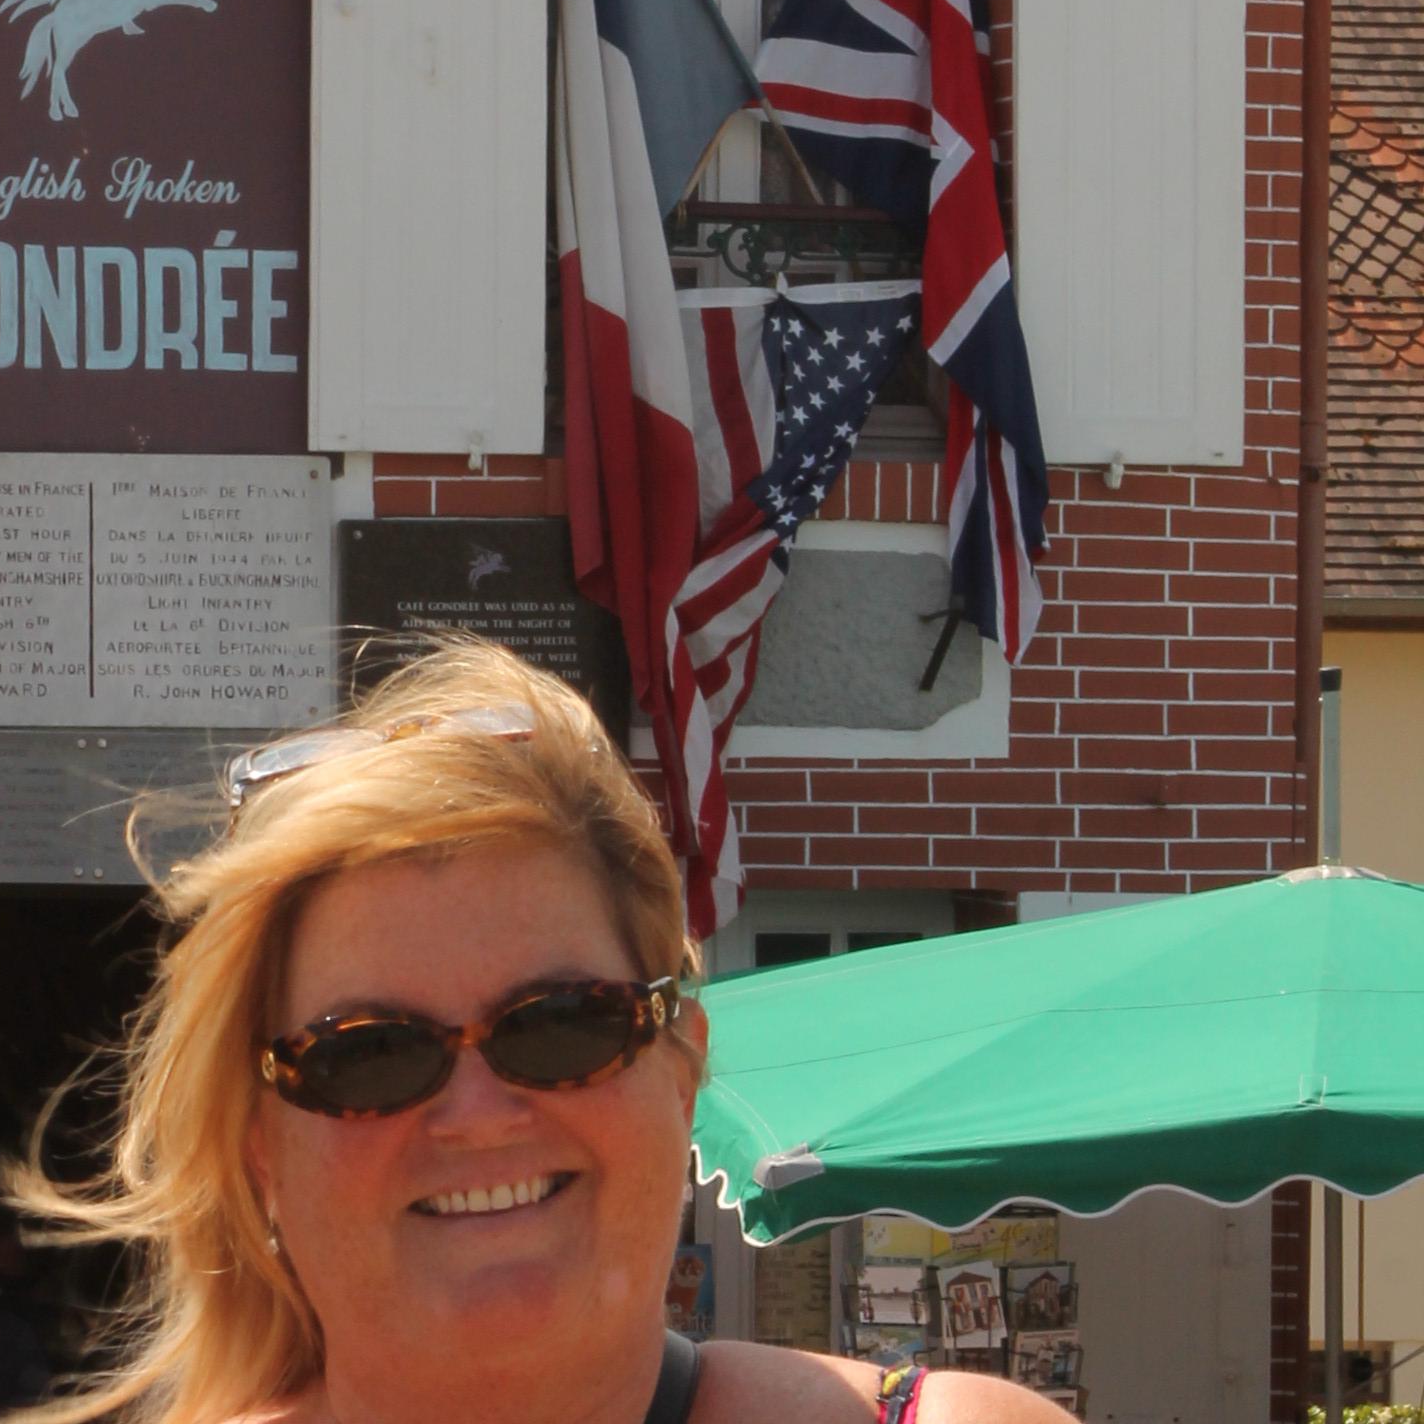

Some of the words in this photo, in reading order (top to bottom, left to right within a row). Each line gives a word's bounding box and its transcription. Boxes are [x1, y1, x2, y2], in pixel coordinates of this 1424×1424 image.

[104, 156, 241, 219] Spoken
[18, 483, 31, 495] IN
[34, 481, 85, 496] FRANCE
[149, 484, 209, 498] MAISON
[219, 486, 236, 498] DE
[30, 529, 71, 541] HOUR
[108, 529, 147, 542] DANS
[158, 530, 175, 542] LA
[6, 550, 32, 562] MEN
[37, 550, 51, 563] OF
[61, 550, 84, 563] THE
[110, 552, 128, 564] DU
[138, 552, 146, 564] 5
[160, 552, 198, 565] JUIN
[211, 553, 248, 565] 1944
[296, 553, 313, 566] LA
[148, 596, 188, 610] LIGHT
[202, 596, 272, 611] INFANTRY
[485, 601, 507, 612] WAS
[511, 601, 538, 612] USED
[542, 602, 554, 612] AS
[559, 602, 575, 612] AN
[160, 620, 178, 632] LA
[218, 618, 290, 633] DIVISION
[402, 618, 423, 628] AID
[458, 618, 488, 629] FROM
[493, 618, 513, 629] THE
[519, 618, 553, 629] NIGHT
[558, 618, 571, 629] OF
[533, 636, 577, 647] SHELTER
[548, 652, 577, 663] WERE
[9, 662, 24, 674] OF
[31, 661, 86, 675] MAJOR
[97, 663, 135, 676] SOUS
[145, 664, 171, 676] LES
[182, 664, 242, 677] ORDRES
[249, 664, 266, 677] DU
[272, 663, 325, 678] MAJOR
[133, 684, 150, 699] R.
[160, 684, 200, 699] JOHN
[211, 685, 289, 700] HOWARD
